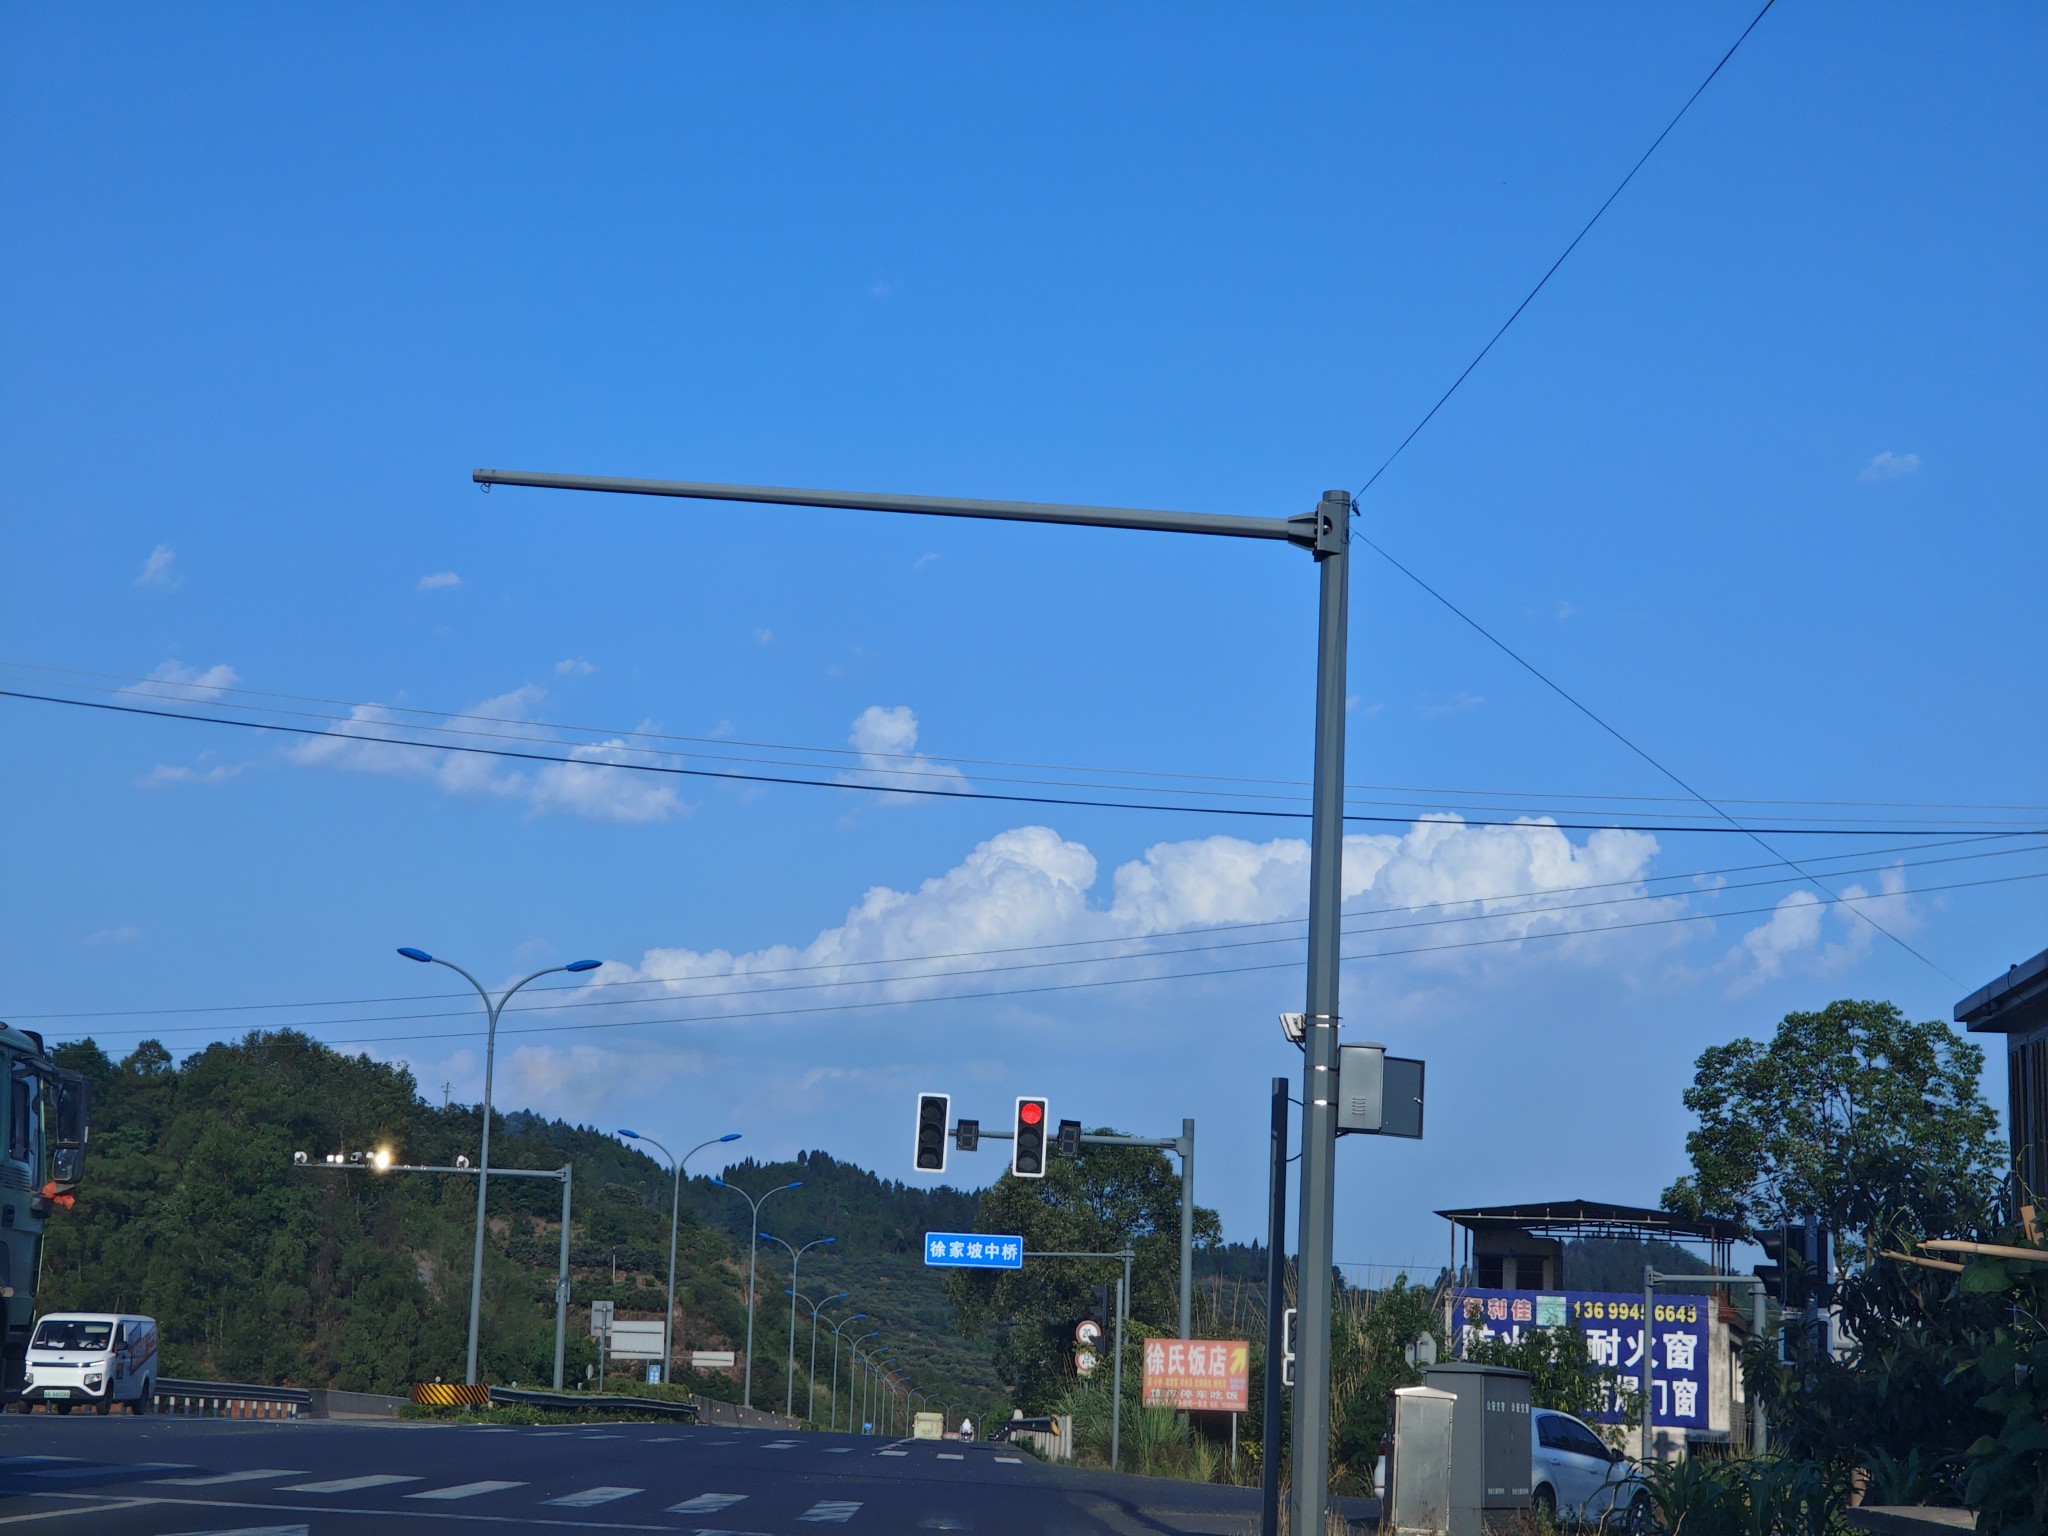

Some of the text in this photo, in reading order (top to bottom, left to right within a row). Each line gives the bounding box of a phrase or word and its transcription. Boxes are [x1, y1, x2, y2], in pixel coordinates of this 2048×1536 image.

[930, 1240, 1018, 1261] 徐家坡中桥
[1146, 1343, 1227, 1377] 徐氏饭店
[1586, 1328, 1698, 1370] 耐火窗
